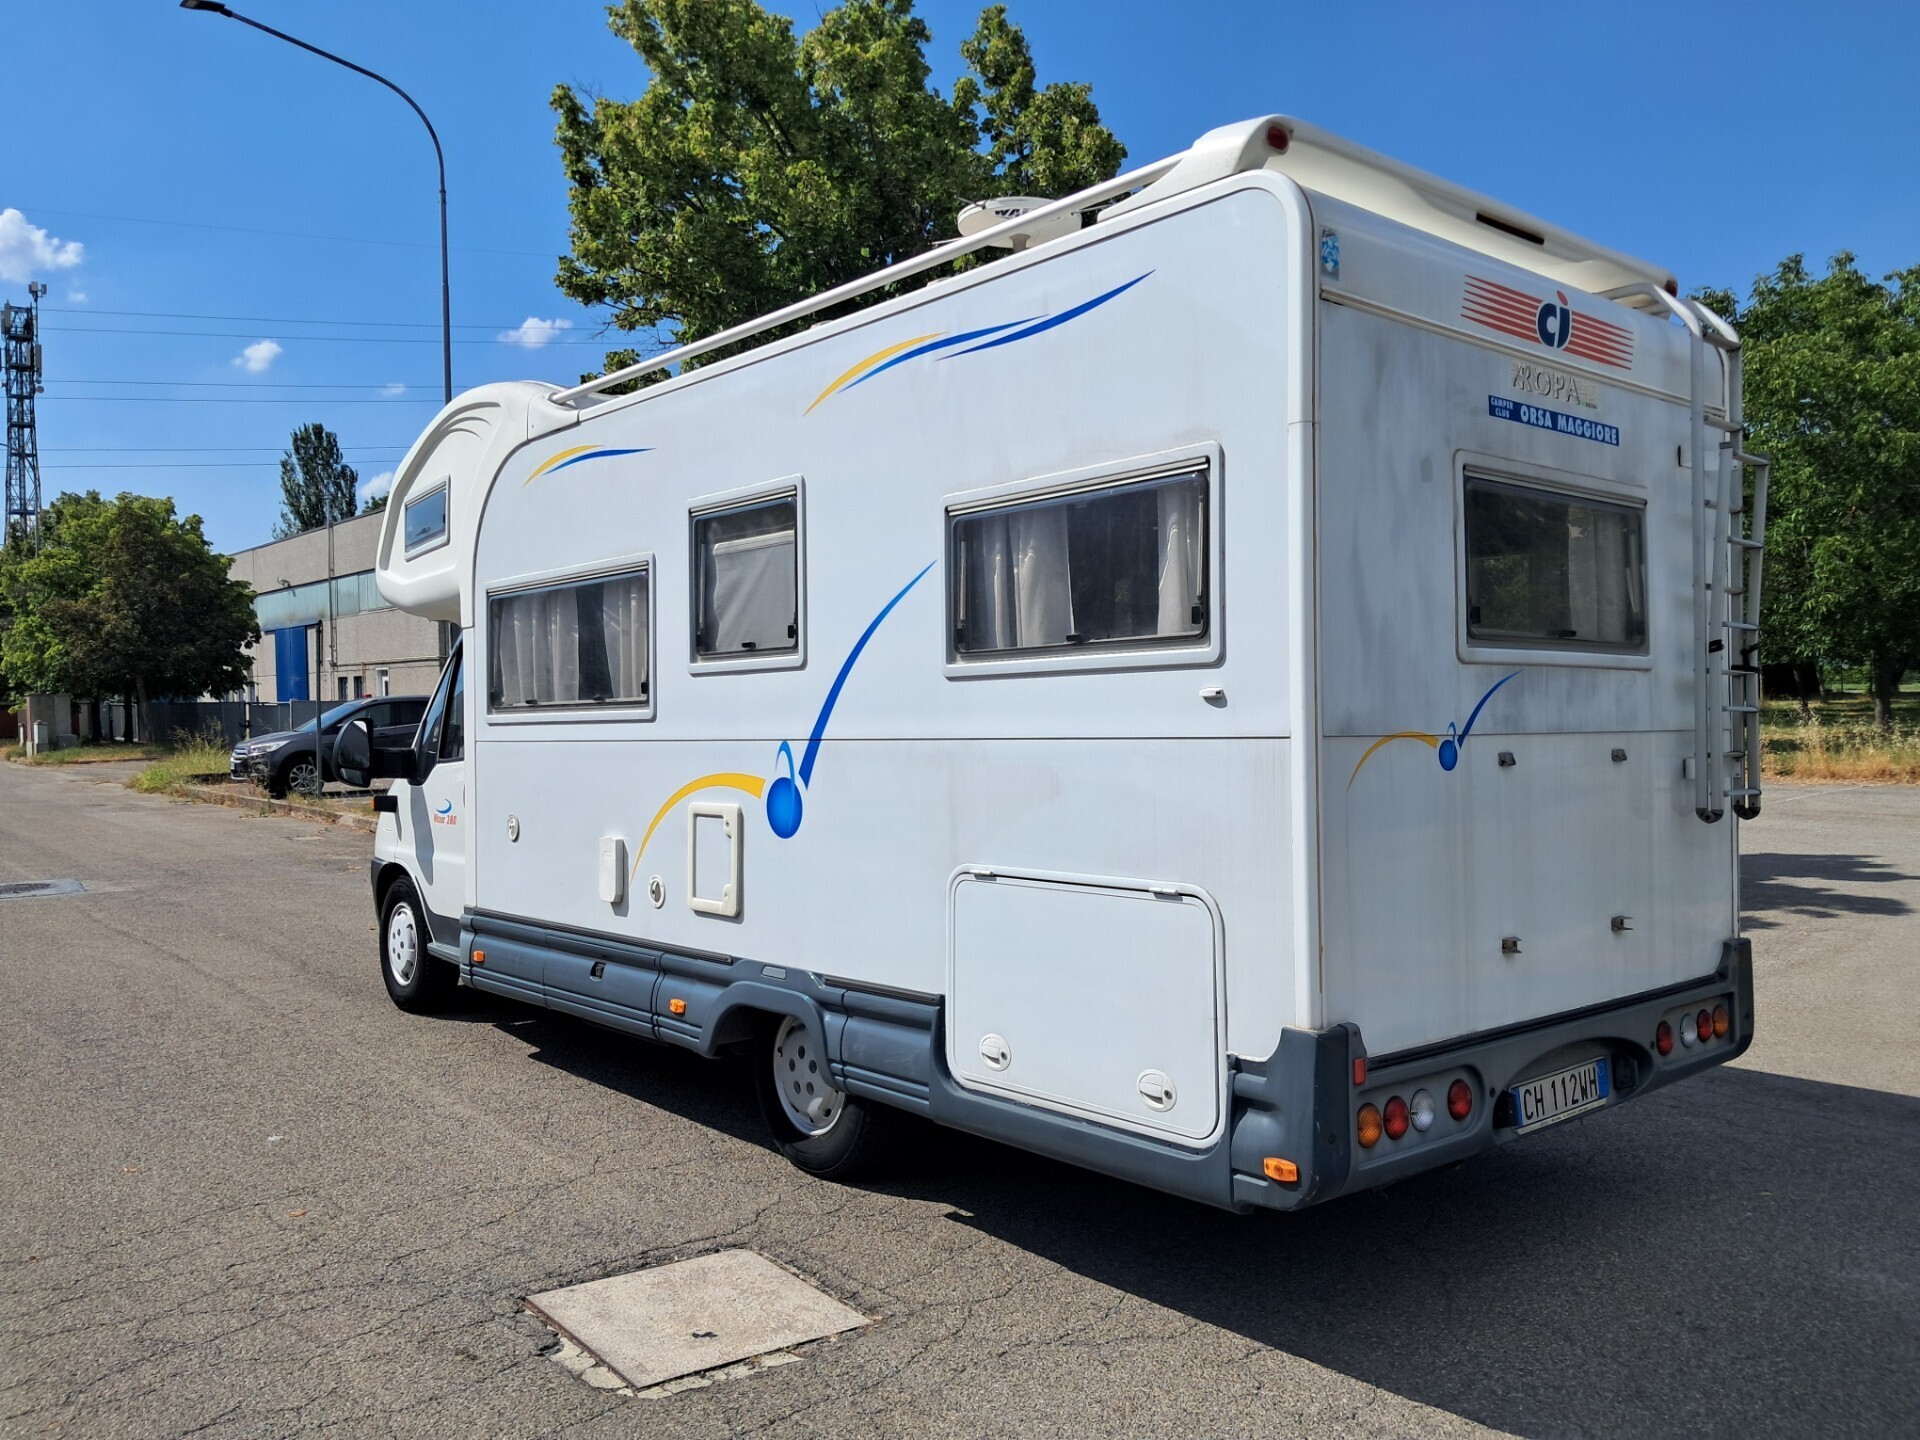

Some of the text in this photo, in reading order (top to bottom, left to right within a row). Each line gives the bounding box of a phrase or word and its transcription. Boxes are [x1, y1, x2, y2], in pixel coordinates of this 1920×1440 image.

[1490, 396, 1514, 410] CAMPER
[1495, 407, 1510, 419] CLUB
[1520, 404, 1618, 445] ORSA MAGGIORE
[1523, 1083, 1546, 1121] CH
[1550, 1066, 1598, 1111] 112WH
